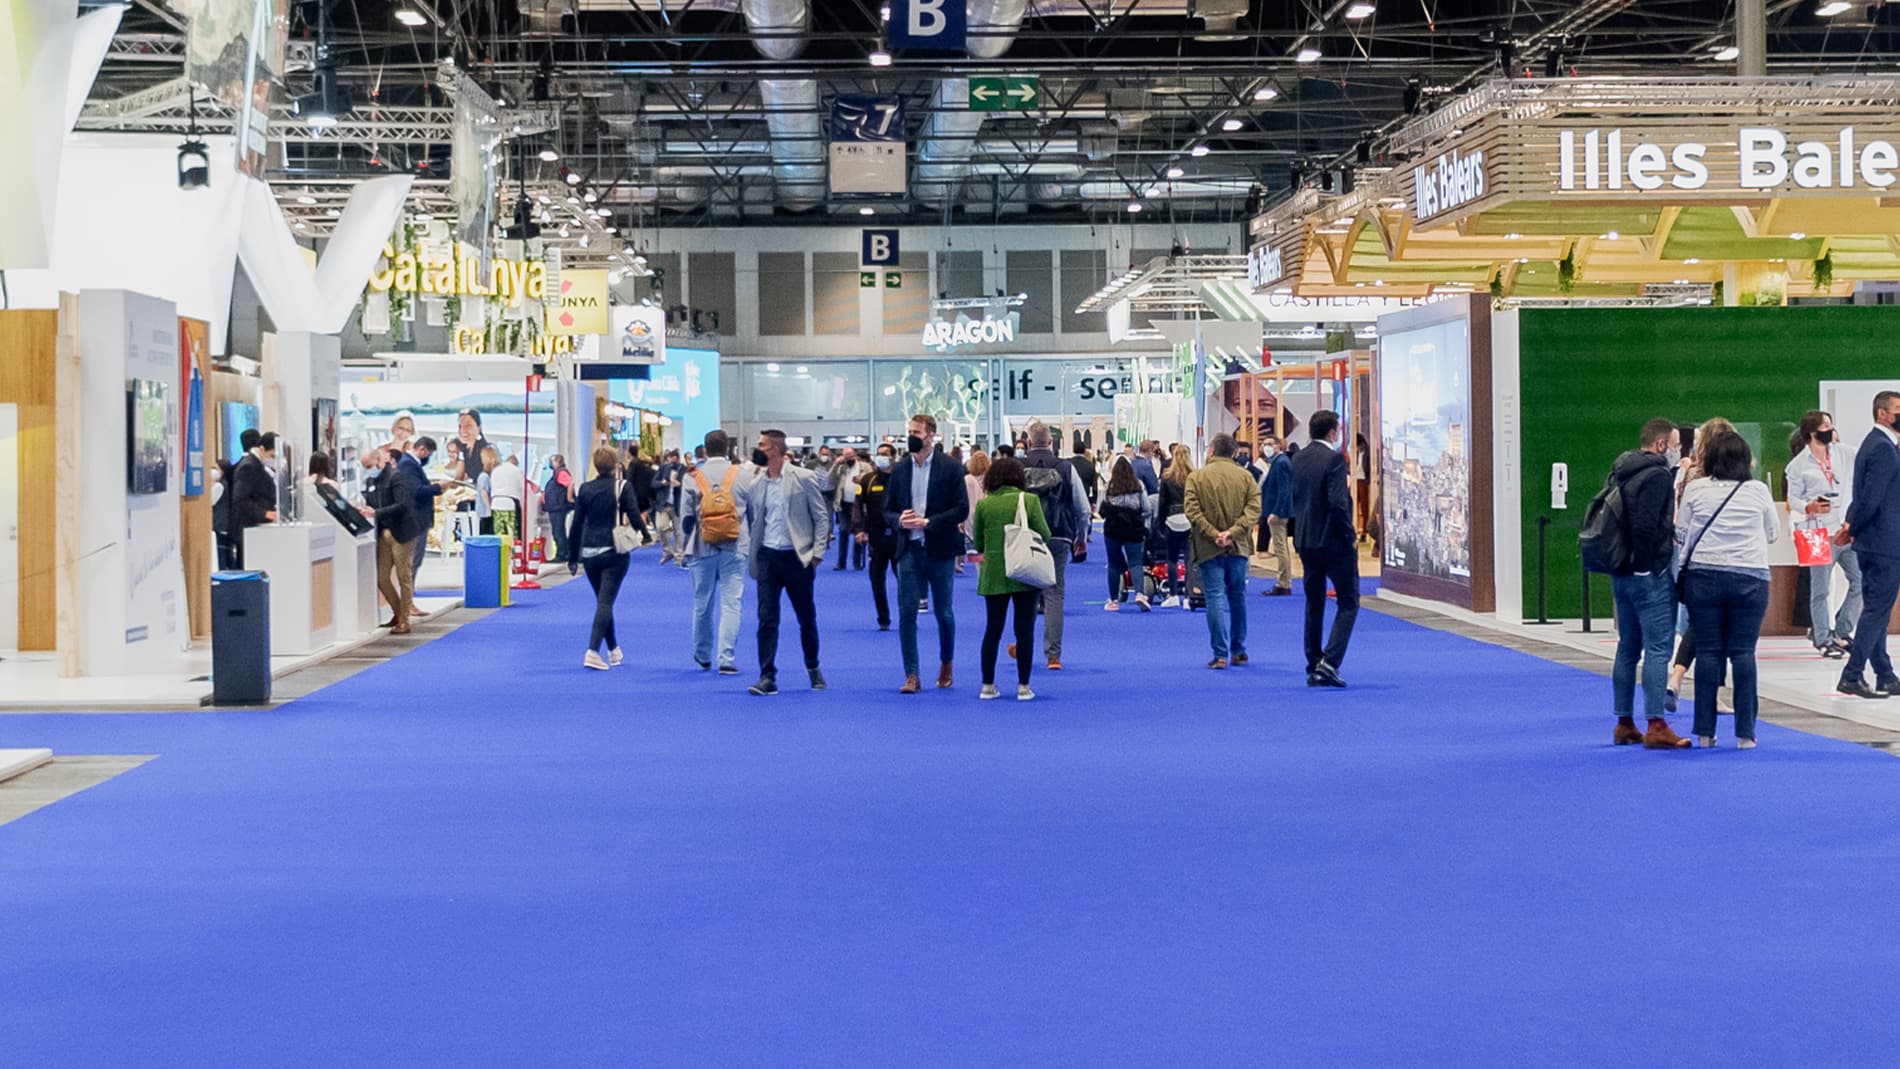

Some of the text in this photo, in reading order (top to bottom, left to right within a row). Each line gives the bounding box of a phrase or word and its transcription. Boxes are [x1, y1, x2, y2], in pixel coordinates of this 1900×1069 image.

[908, 0, 947, 36] B
[1415, 148, 1483, 219] Illes Balears
[1560, 128, 1709, 190] Illes
[871, 235, 890, 260] B
[368, 240, 547, 308] Catalunya
[922, 314, 1014, 350] ARAGÓN
